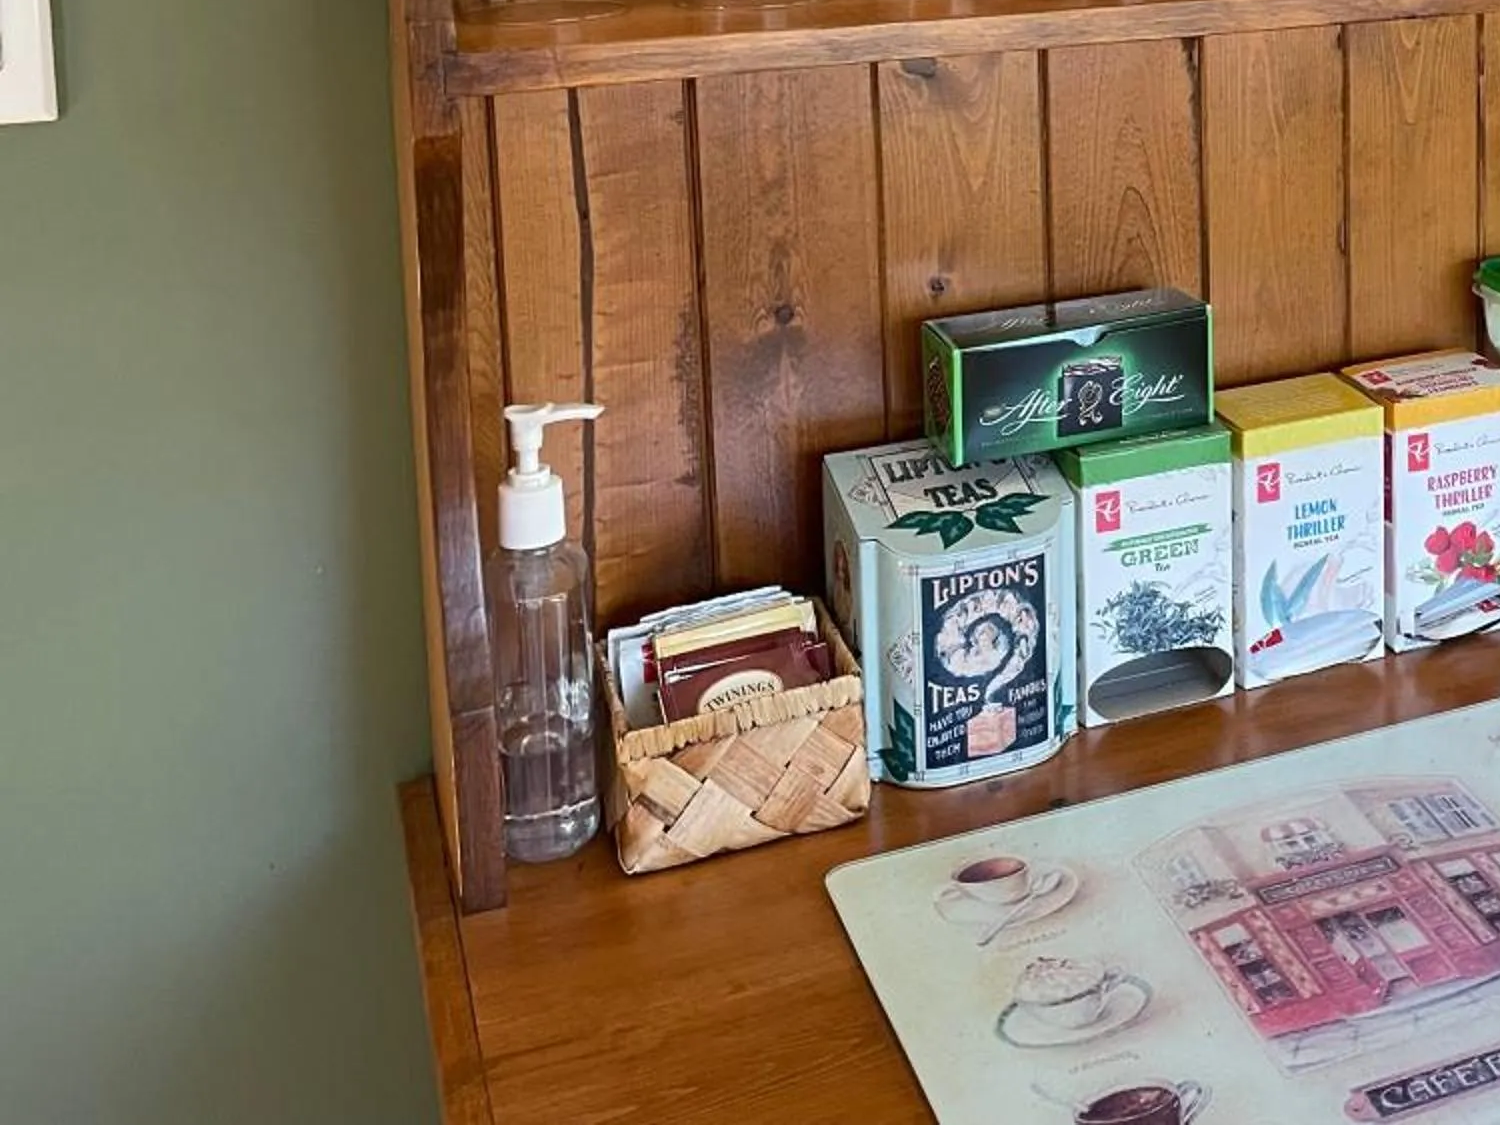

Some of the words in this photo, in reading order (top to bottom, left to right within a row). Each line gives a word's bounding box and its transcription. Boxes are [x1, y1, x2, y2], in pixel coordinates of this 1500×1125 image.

[979, 388, 1072, 436] After
[1109, 373, 1185, 416] Eight
[923, 477, 999, 508] TEAS
[1427, 464, 1498, 492] RASPBERRY
[1294, 498, 1337, 520] LEMON
[1434, 484, 1494, 510] THRILLER
[1286, 514, 1345, 541] THRILLER
[1120, 538, 1200, 568] GREEN
[932, 560, 1039, 610] LIPTON'S
[703, 681, 775, 712] TWININGS
[928, 682, 981, 715] TEAS
